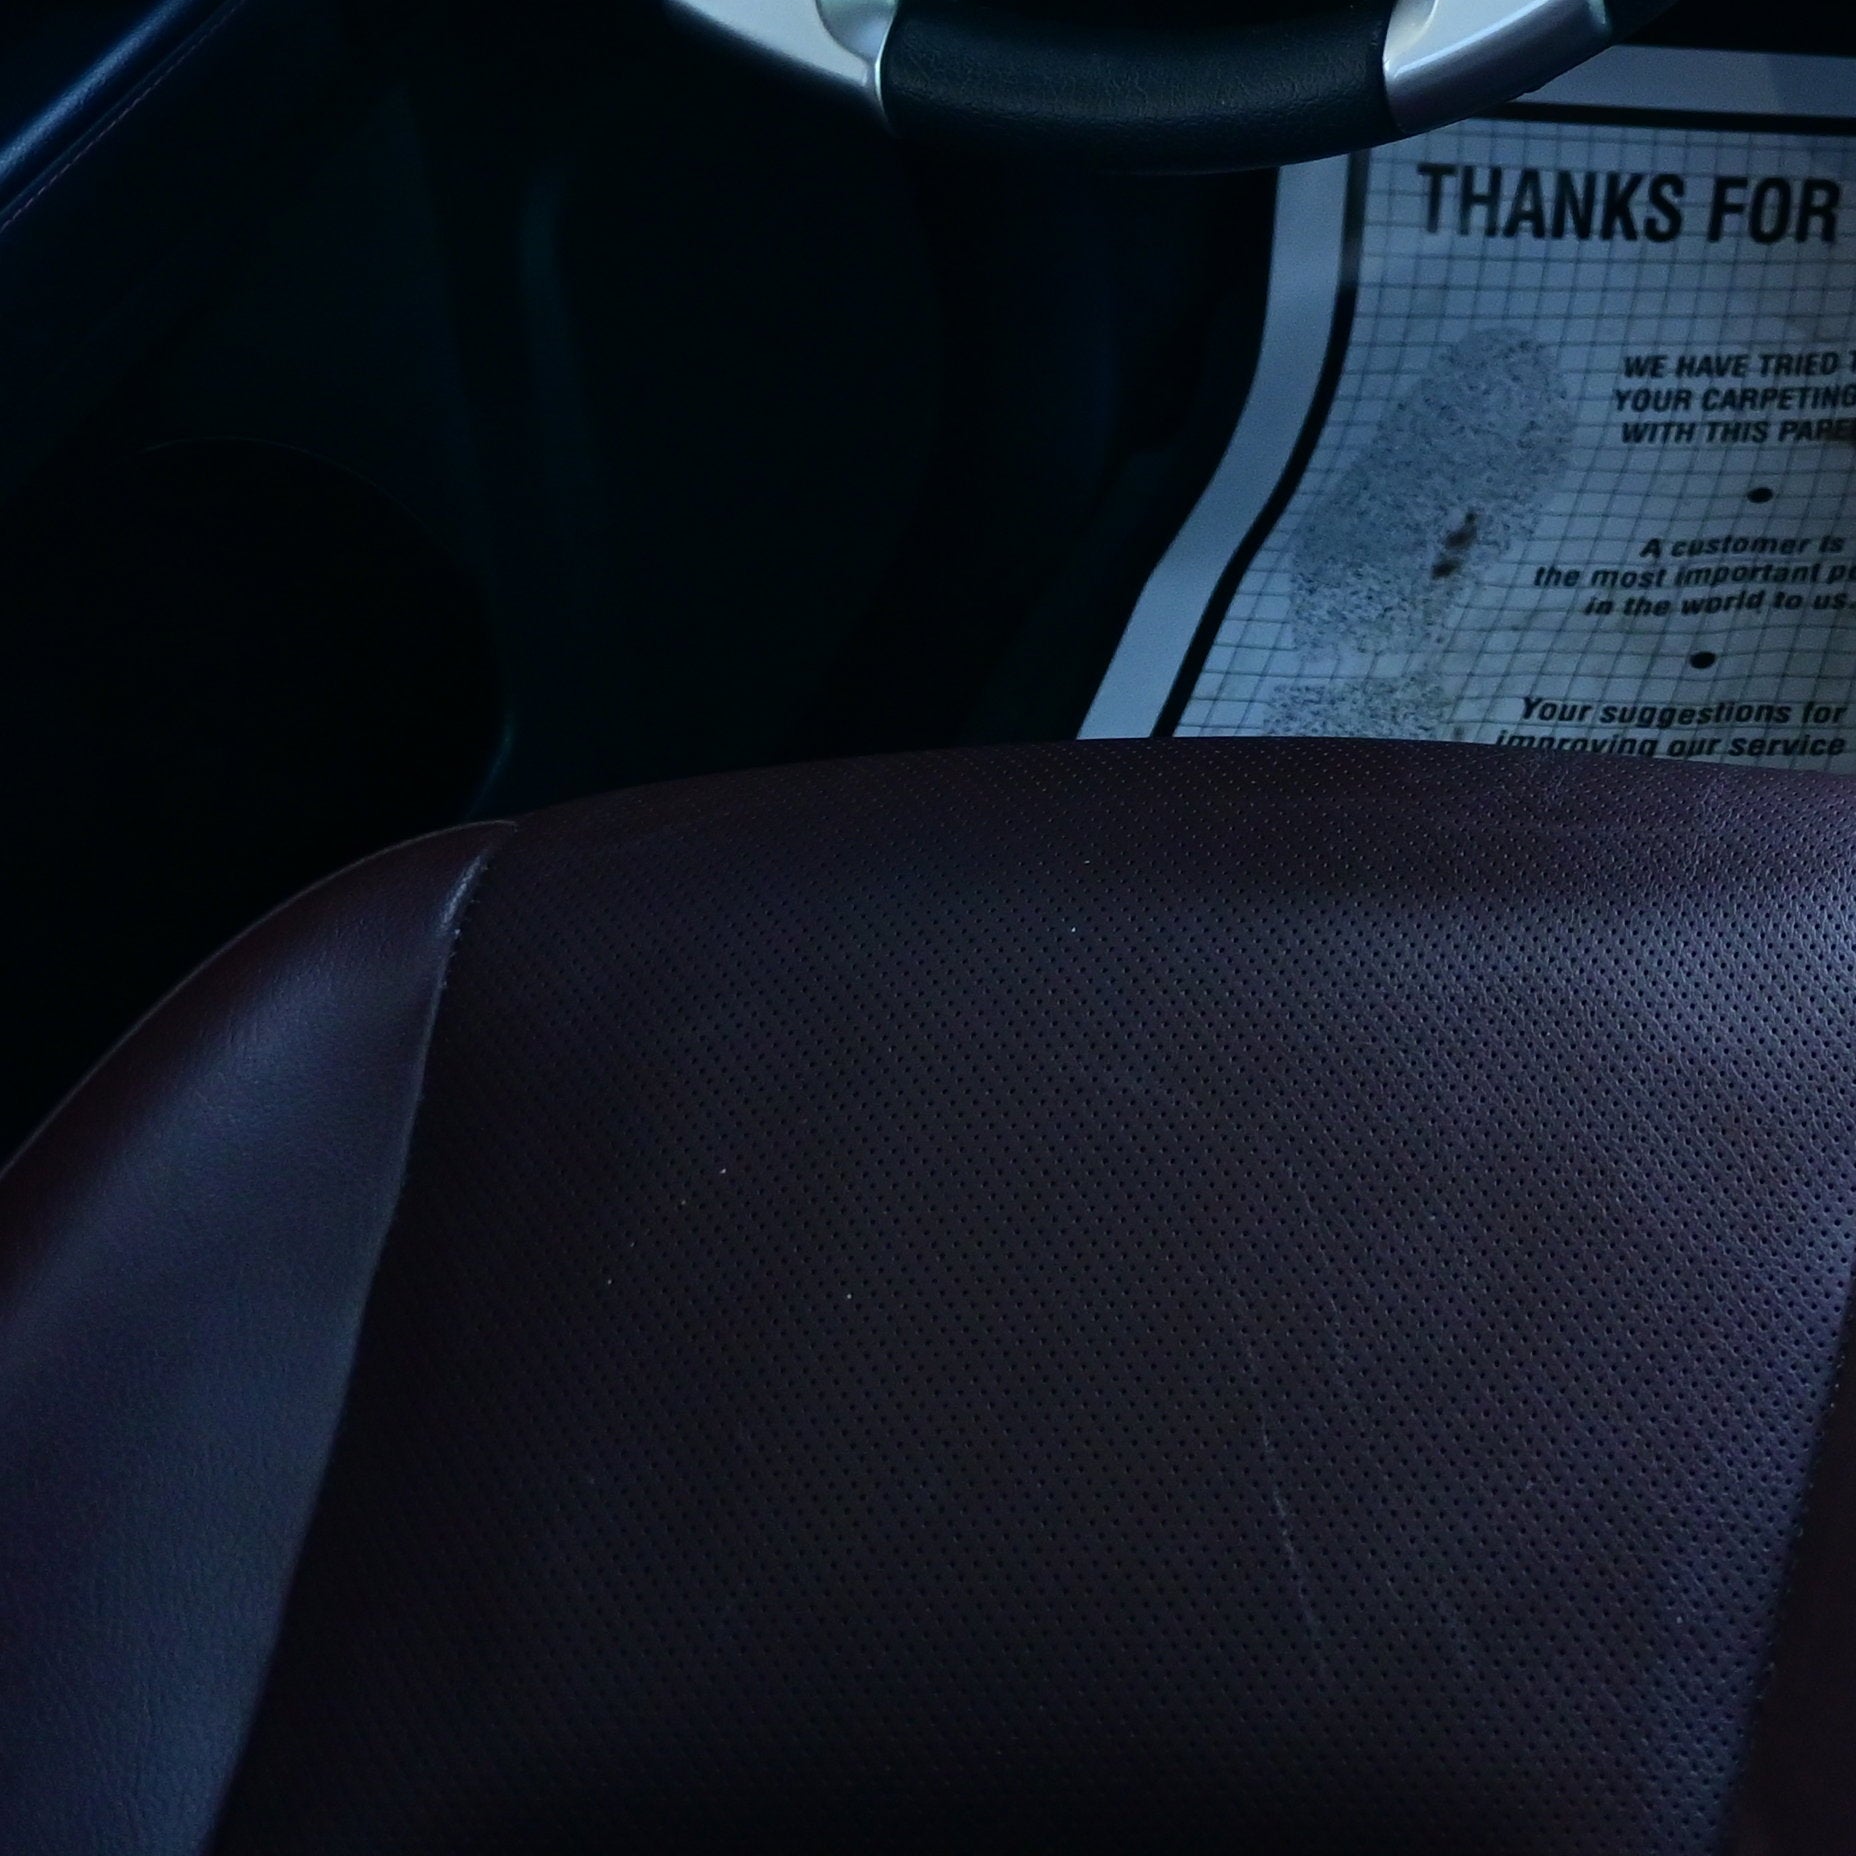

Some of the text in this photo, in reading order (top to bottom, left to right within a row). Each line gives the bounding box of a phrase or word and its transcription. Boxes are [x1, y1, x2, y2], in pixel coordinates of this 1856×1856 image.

[1417, 162, 1685, 244] THANKS
[1707, 175, 1841, 244] FOR
[1623, 354, 1667, 378] WE
[1675, 353, 1751, 378] HAVE
[1758, 351, 1840, 376] TRIED
[1612, 387, 1693, 412] YOUR
[1620, 421, 1697, 444] WITH
[1704, 421, 1770, 444] THIS
[1639, 533, 1845, 559] A customer is
[1534, 565, 1581, 588] the
[1590, 566, 1666, 589] most
[1674, 561, 1821, 590] important
[1583, 595, 1614, 617] in
[1623, 594, 1669, 617] the
[1680, 589, 1763, 617] world
[1773, 590, 1804, 611] to
[1520, 695, 1847, 730] Your suggestions for
[1666, 734, 1722, 759] our
[1727, 734, 1846, 757] service
